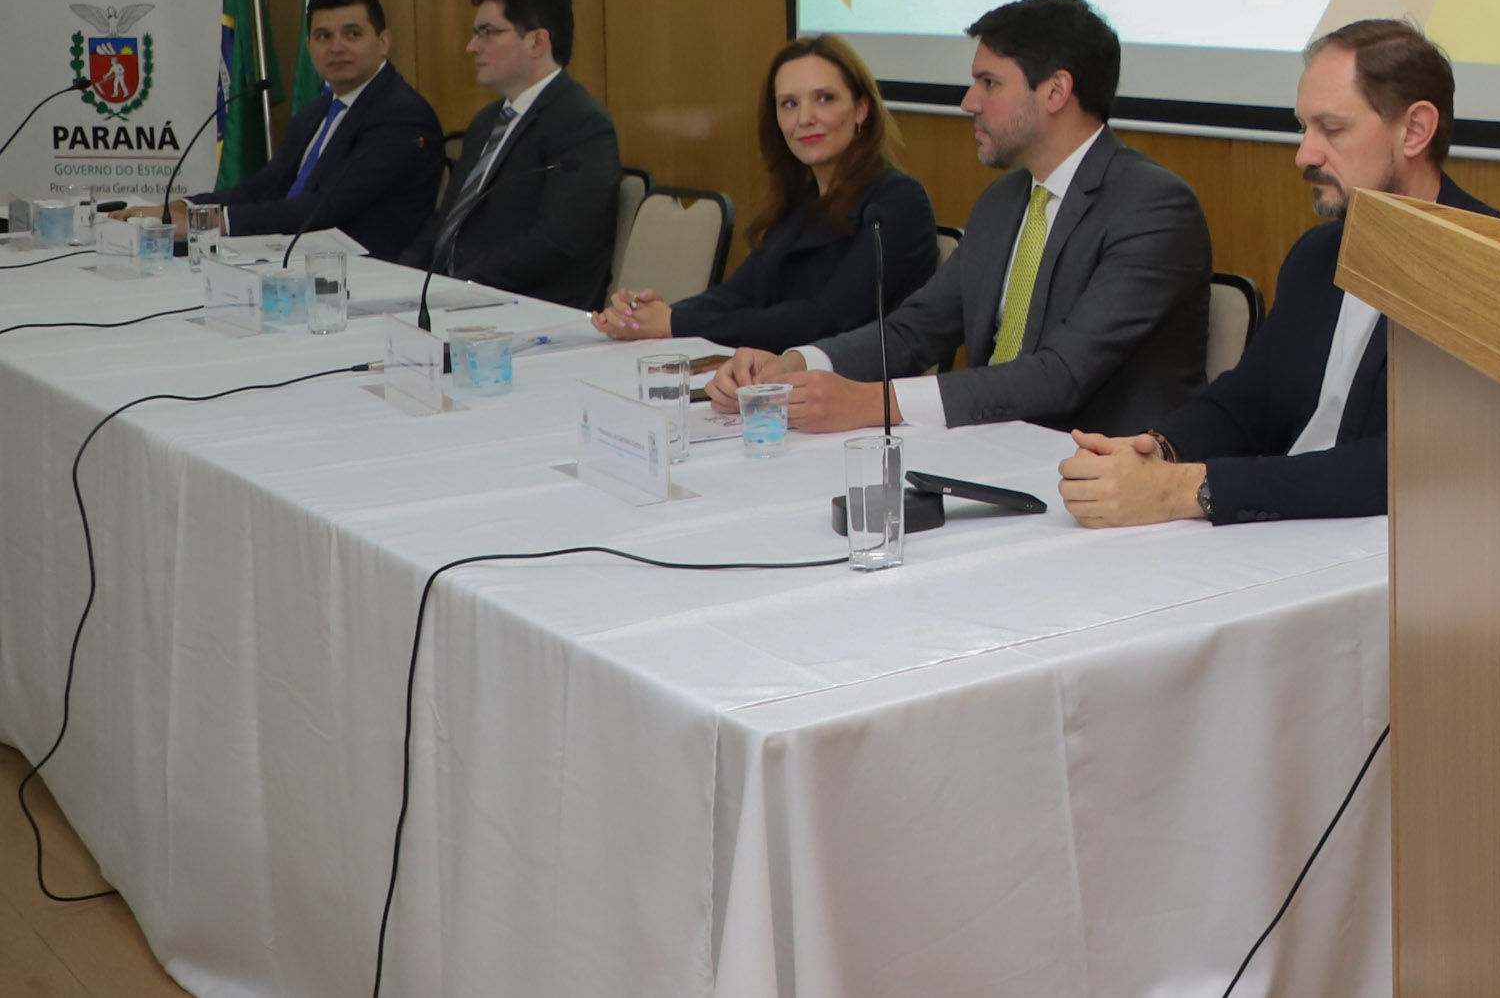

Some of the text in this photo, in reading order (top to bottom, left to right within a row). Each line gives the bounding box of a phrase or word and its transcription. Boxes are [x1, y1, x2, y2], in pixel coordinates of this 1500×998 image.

[53, 121, 180, 150] PARANÁ
[54, 163, 112, 176] GOVERNO
[115, 165, 134, 177] DO
[112, 183, 138, 195] Geral
[141, 183, 153, 194] do
